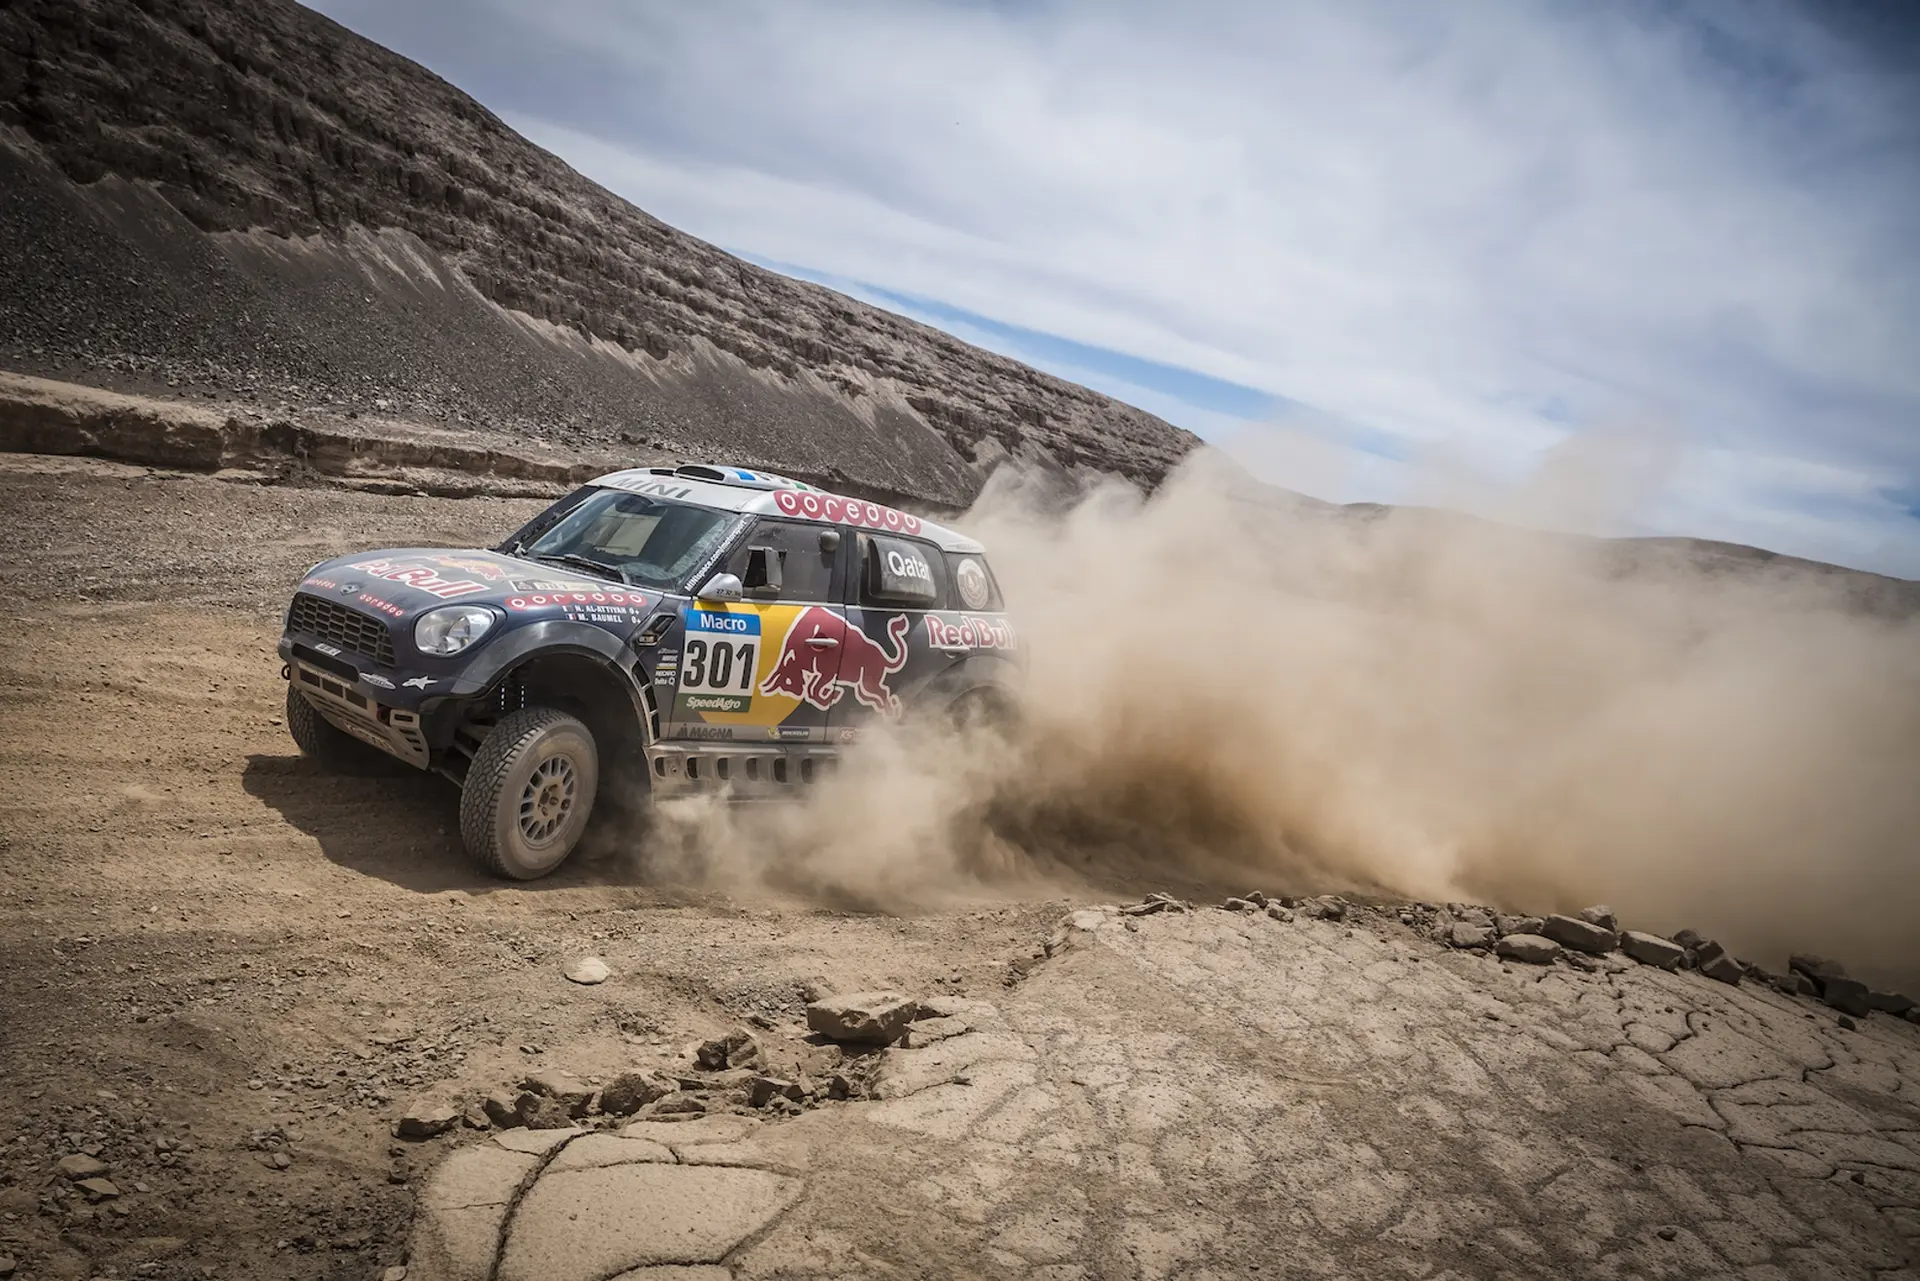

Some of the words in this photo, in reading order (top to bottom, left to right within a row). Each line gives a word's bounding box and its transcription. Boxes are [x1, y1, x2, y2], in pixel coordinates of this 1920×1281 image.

[611, 477, 692, 499] MINI
[779, 493, 918, 529] ooredoo
[888, 551, 931, 582] Qatar
[359, 594, 405, 617] ooredoo
[511, 592, 642, 608] ooredoo
[700, 613, 747, 631] Macro
[924, 614, 979, 649] Red
[683, 640, 755, 689] 301
[686, 696, 741, 712] SpeedAgro
[690, 727, 733, 739] MAGNA
